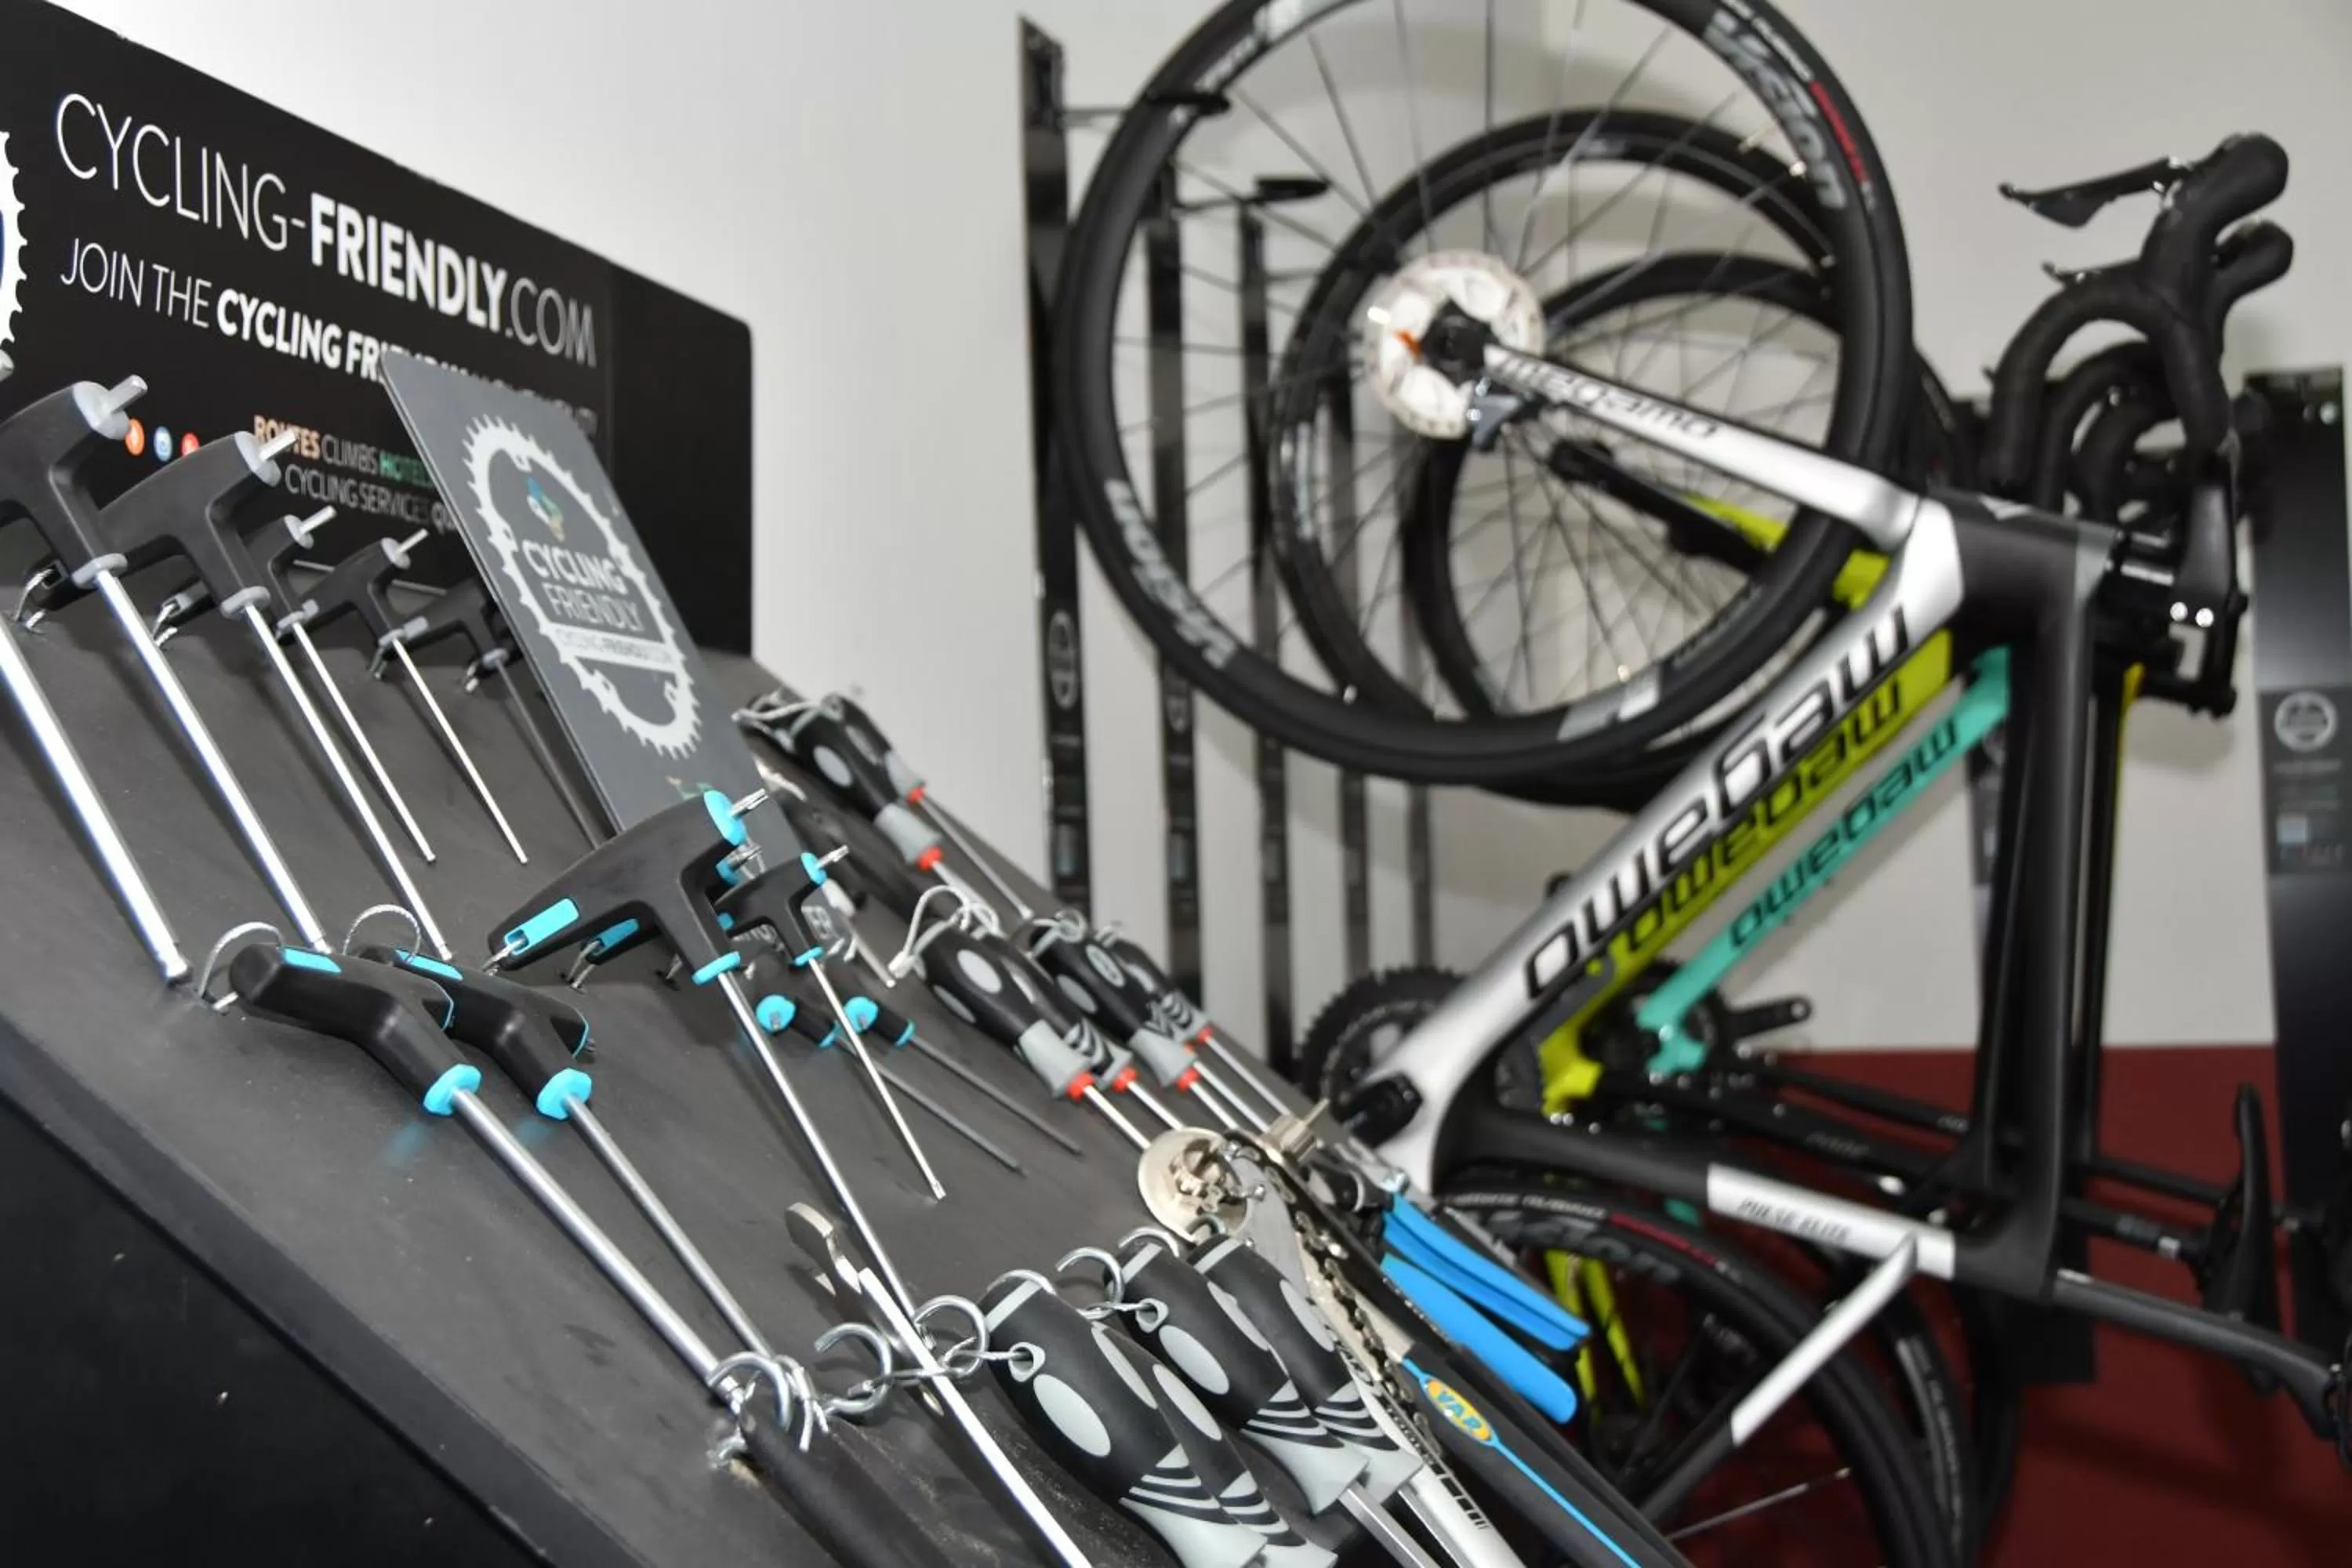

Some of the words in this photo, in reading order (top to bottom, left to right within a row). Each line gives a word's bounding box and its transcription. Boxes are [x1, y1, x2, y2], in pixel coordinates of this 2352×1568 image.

[60, 238, 144, 307] JOIN
[152, 263, 212, 328] THE
[216, 288, 343, 369] CYCLING
[321, 434, 378, 475] CLIMBS
[285, 463, 358, 509] CYCLING
[522, 539, 628, 595] CYCLING
[542, 582, 644, 631] FRIENDLY
[1524, 604, 1911, 1000] megamo
[1624, 676, 1902, 954] megamo
[1730, 713, 1958, 948] megamo
[1436, 1389, 1483, 1429] VAR
